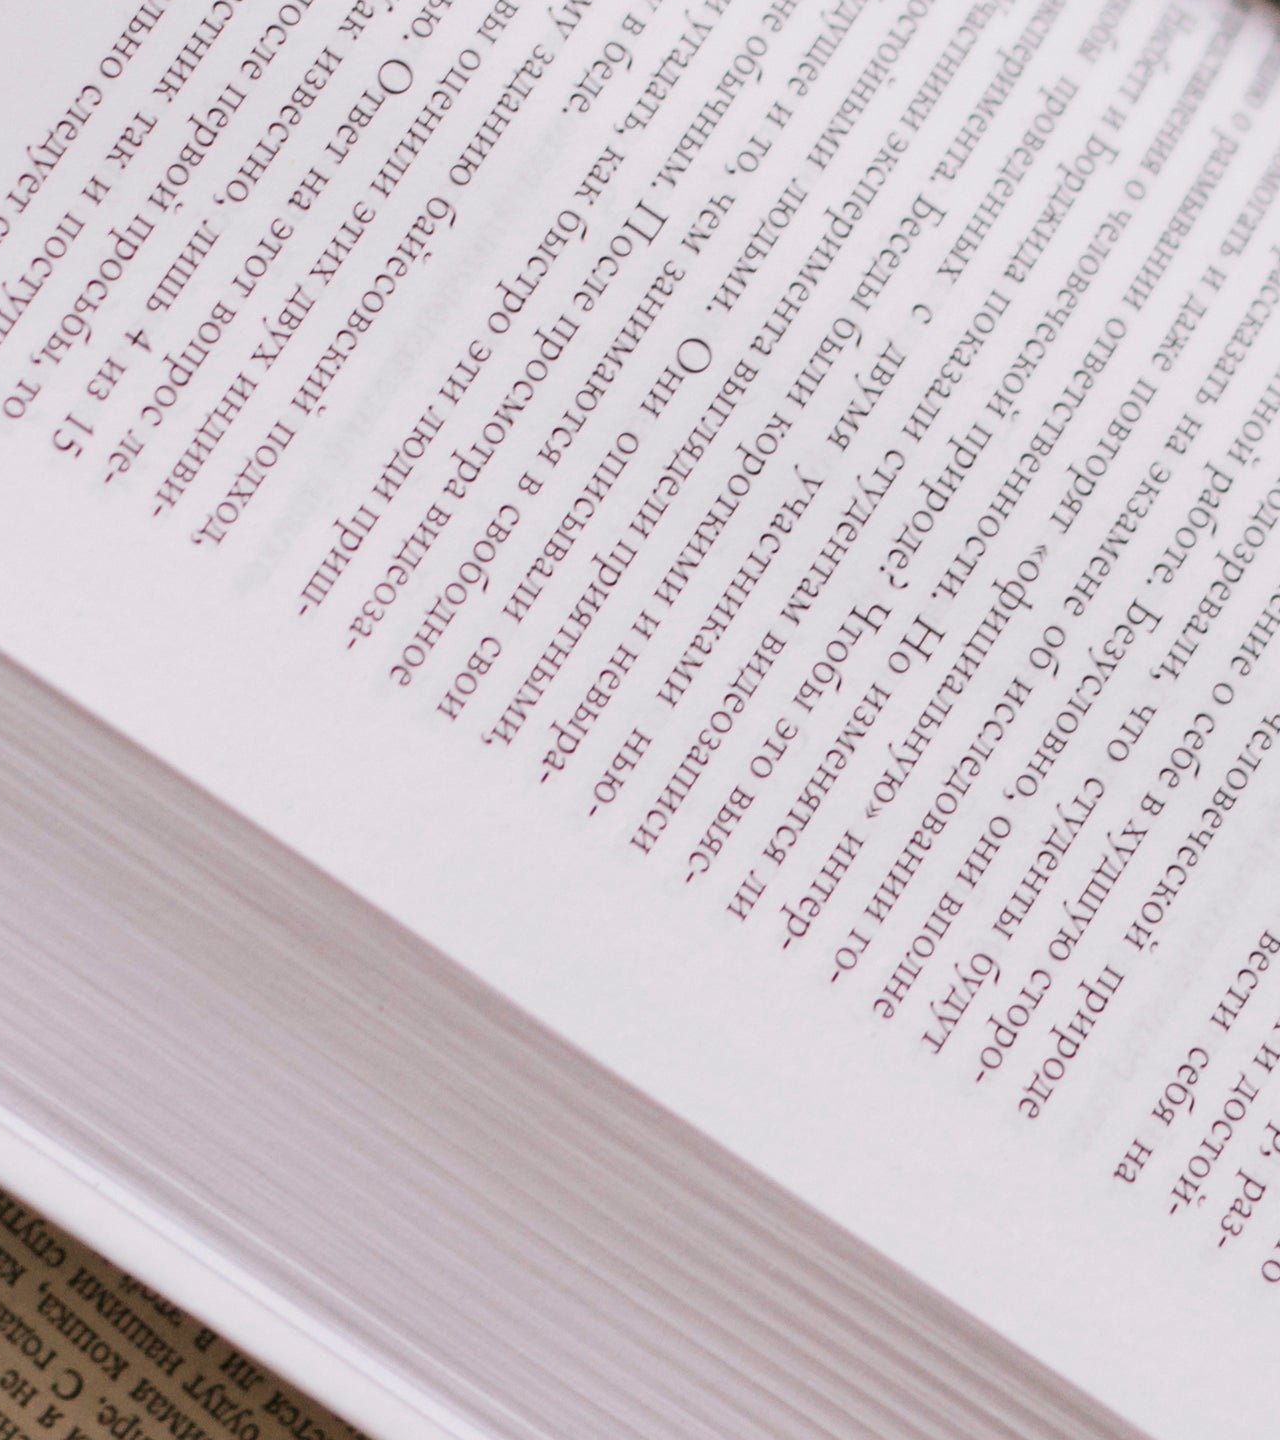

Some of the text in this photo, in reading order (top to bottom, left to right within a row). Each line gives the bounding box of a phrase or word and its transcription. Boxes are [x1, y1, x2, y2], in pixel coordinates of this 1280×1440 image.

[4, 83, 104, 215] следует
[211, 44, 345, 207] известно,
[447, 42, 557, 188] заданию
[144, 217, 222, 314] лишь
[289, 195, 458, 417] байесовский
[85, 354, 129, 403] из
[122, 327, 154, 354] 4
[50, 410, 96, 460] 15
[189, 418, 298, 547] подход,
[871, 596, 1166, 1021] Безусловно, они вполне
[1216, 1166, 1268, 1250] раз-
